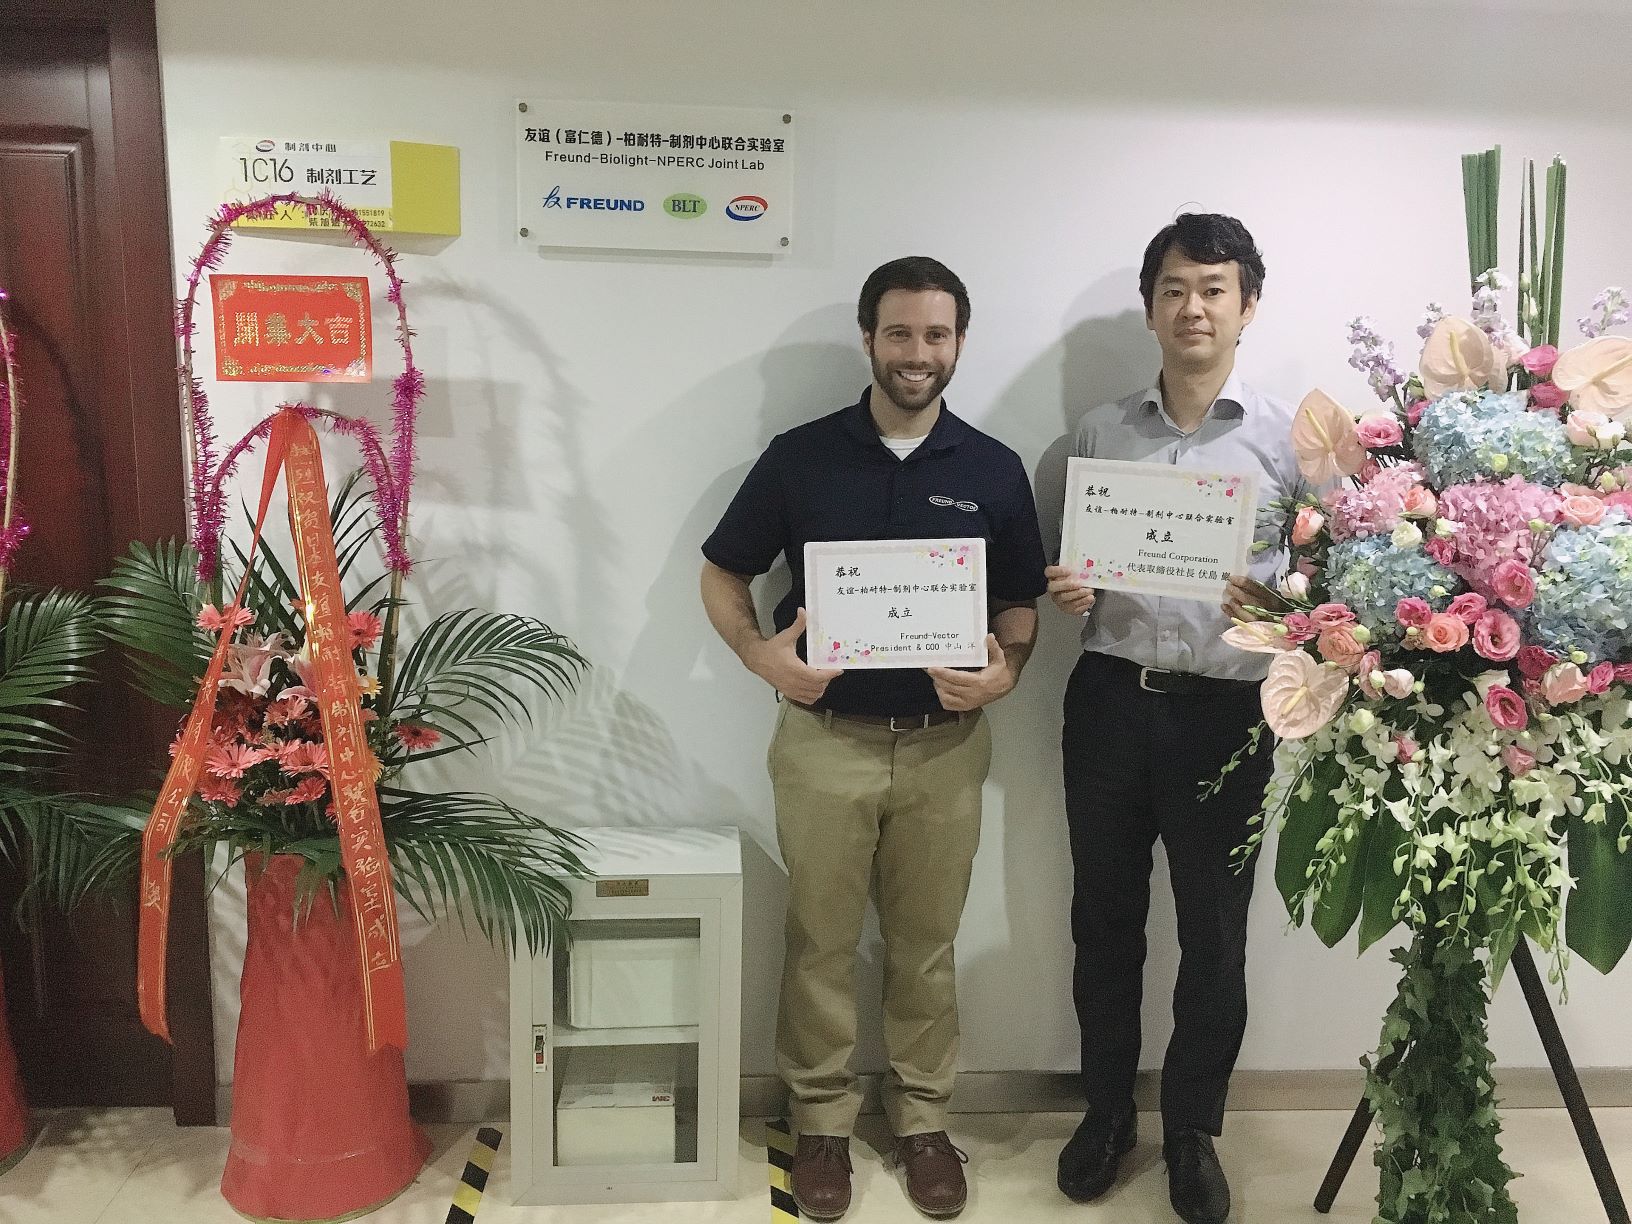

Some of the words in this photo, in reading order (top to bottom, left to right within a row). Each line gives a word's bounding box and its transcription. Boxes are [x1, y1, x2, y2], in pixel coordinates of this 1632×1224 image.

[284, 142, 337, 153] 制剂中心
[545, 150, 705, 168] Freund-Biolight-NPERC
[708, 156, 739, 170] Joint
[742, 158, 765, 170] Lab
[239, 157, 294, 183] 1C16
[306, 168, 377, 186] 制剂工艺
[566, 197, 645, 212] FREUND
[671, 199, 701, 213] BLT
[735, 203, 761, 212] NPERC
[1085, 484, 1111, 498] 恭祝
[1145, 528, 1174, 544] 成立
[1138, 549, 1167, 559] Freund
[1169, 552, 1219, 564] Corporation
[835, 565, 861, 578] 恭祝
[887, 606, 913, 619] 成立
[900, 632, 960, 640] Freund-Vector
[870, 644, 912, 652] President
[916, 643, 922, 651] &
